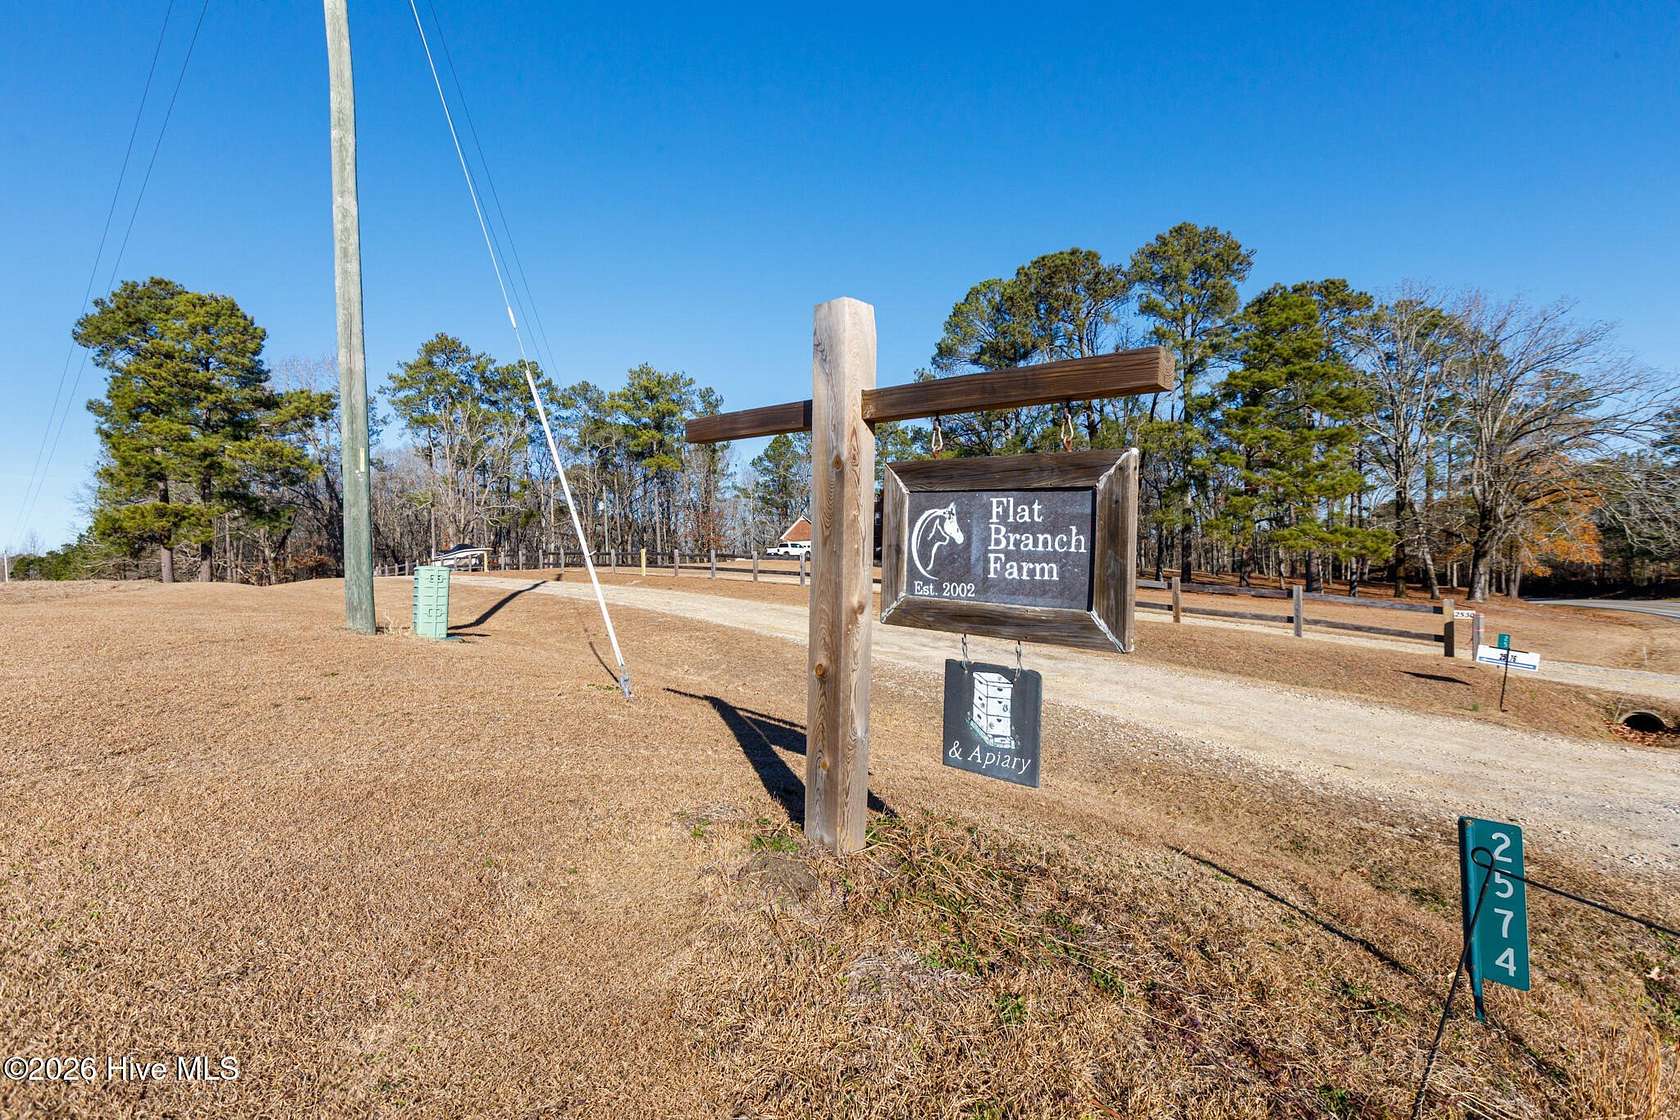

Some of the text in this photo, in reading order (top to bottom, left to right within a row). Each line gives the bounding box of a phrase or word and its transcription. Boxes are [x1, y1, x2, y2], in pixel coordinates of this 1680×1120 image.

[989, 497, 1043, 523] Flat
[987, 524, 1087, 553] Branch
[987, 554, 1059, 581] Farm
[913, 581, 976, 597] Est. 2002
[948, 740, 1031, 775] & Apiary
[1491, 832, 1517, 977] 2574
